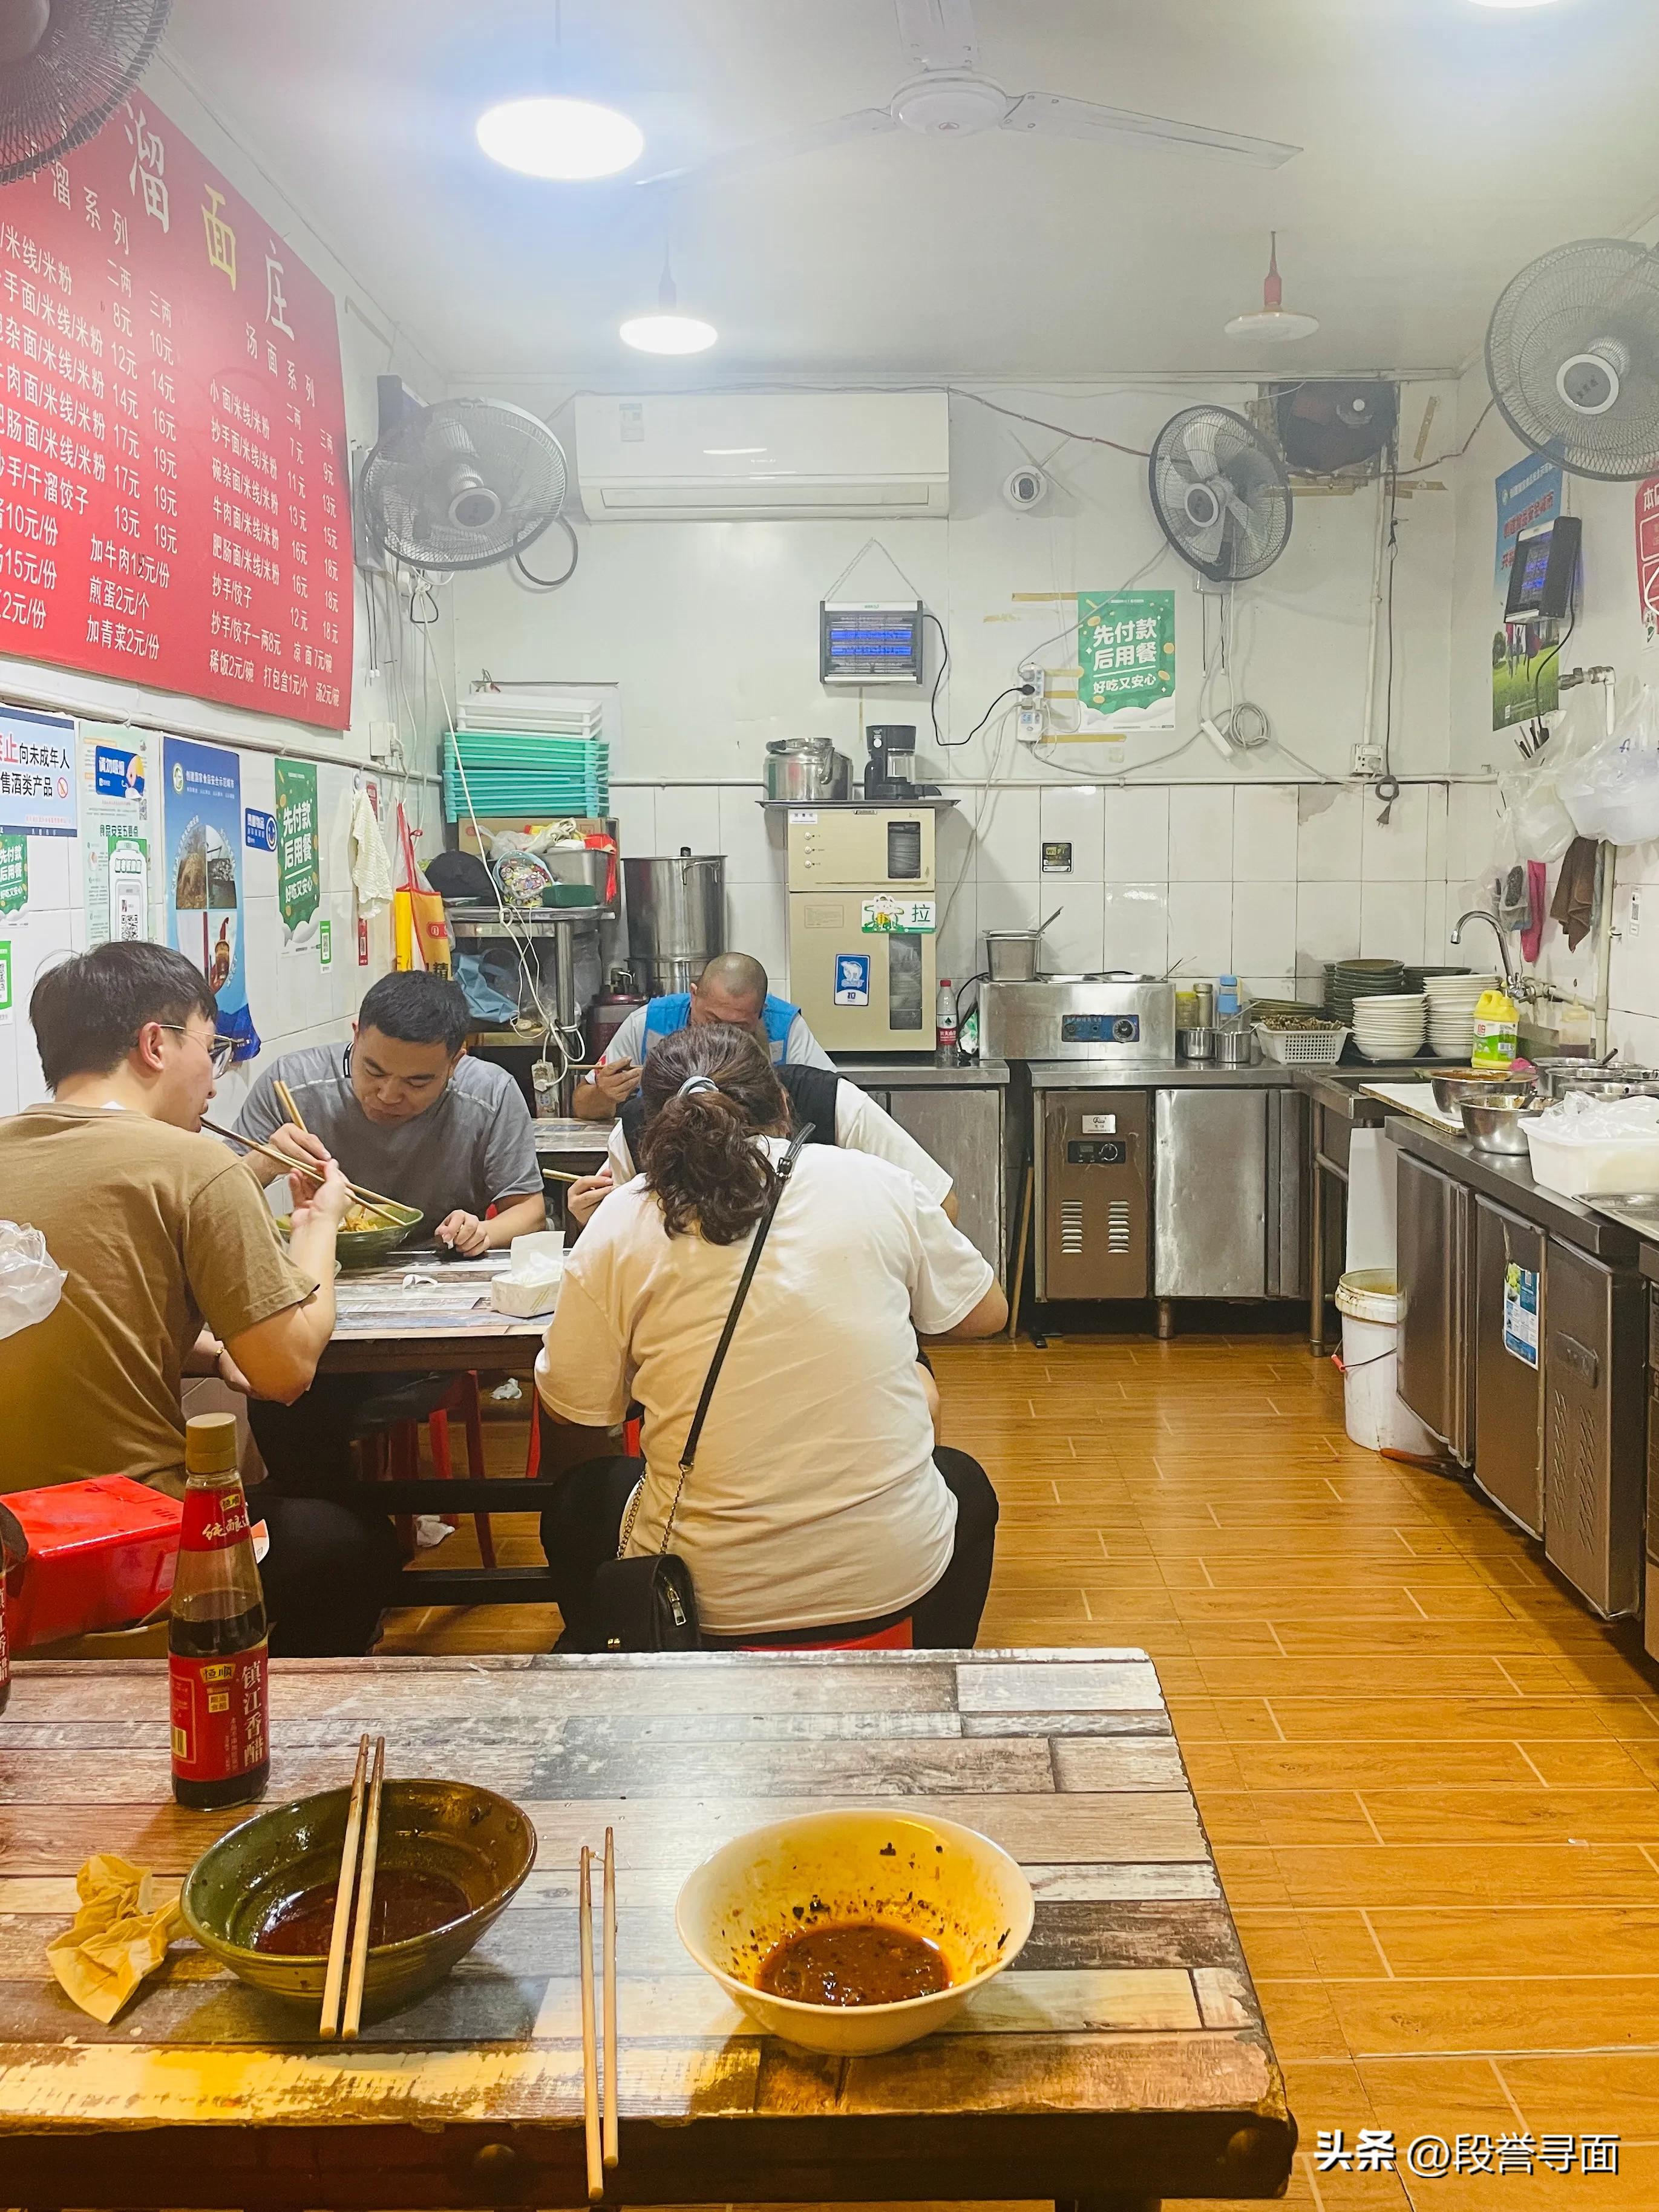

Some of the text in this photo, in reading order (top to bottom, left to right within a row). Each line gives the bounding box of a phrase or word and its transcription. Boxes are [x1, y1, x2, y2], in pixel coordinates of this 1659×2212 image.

[107, 258, 172, 328] 二两 三两
[0, 269, 175, 404] 手面/米线/米粉 12元 14元
[113, 302, 133, 338] 8元
[149, 329, 174, 365] 10元
[246, 321, 315, 407] 汤面系列
[0, 313, 177, 442] 杂面/米线/米粉 14元 16元
[0, 362, 177, 480] 肉面/米线/米粉 17元 19元
[210, 378, 270, 440] 小面/米线/米粉
[289, 437, 304, 465] 7元
[286, 402, 301, 431] 二两
[0, 402, 178, 517] 肠面/米线/米粉 17元 19元
[211, 416, 336, 519] 抄手面/米线/米粉 11元 13元
[114, 504, 140, 539] 13元
[154, 523, 178, 555] 19元
[212, 494, 339, 581] 牛肉面/米线/米粉 16元 18元
[289, 504, 307, 532] 13元
[323, 525, 338, 550] 15元
[0, 543, 150, 621] 15元/份 煎蛋2元/个
[212, 532, 339, 613] 肥肠面/米线/米粉 16元 18元
[0, 587, 160, 660] 2元/份 加青菜2元/份
[212, 571, 339, 644] 抄手/饺子 12元 18元
[1093, 617, 1157, 647] 先付款
[1092, 673, 1157, 695] 好吃又安心
[1093, 641, 1157, 671] 后用餐
[0, 733, 70, 770] 止向未成年人
[1, 771, 53, 797] 售酒类产品
[283, 800, 312, 837] 先付款
[284, 833, 312, 871] 后用餐
[285, 875, 313, 903] 好吃又安心
[911, 903, 931, 923] 拉
[203, 1665, 232, 1681] 恒顺
[242, 1660, 264, 1767] 镇江香醋
